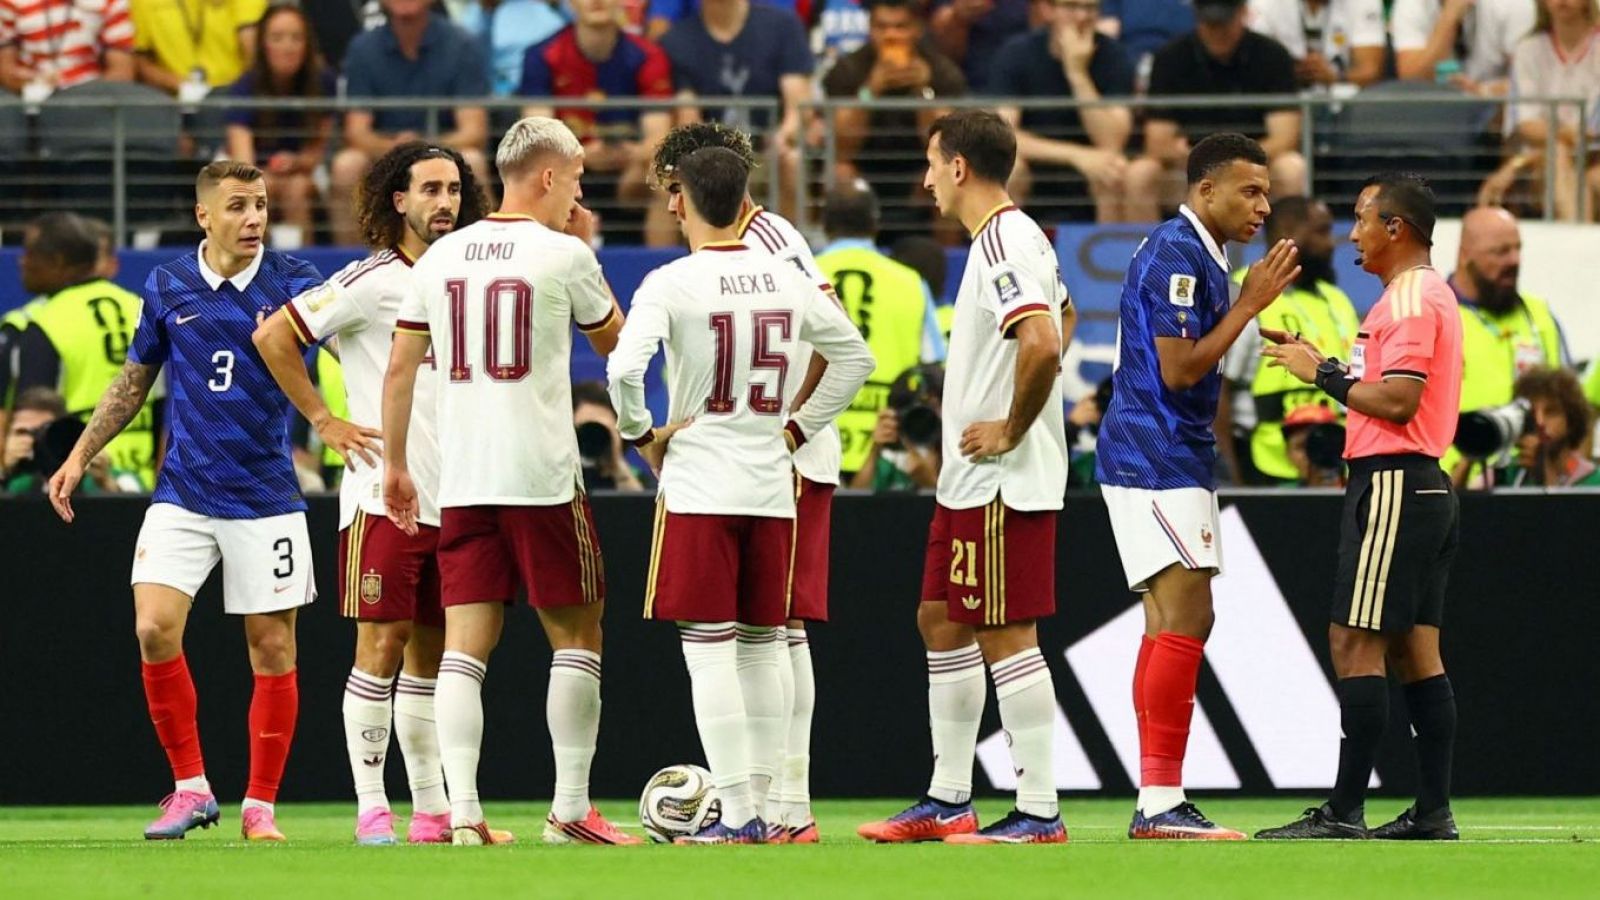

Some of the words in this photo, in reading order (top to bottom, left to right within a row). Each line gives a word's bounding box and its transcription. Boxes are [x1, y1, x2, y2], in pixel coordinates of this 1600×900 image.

[465, 242, 514, 261] OLMO
[720, 275, 760, 296] ALEX
[764, 274, 781, 295] B.
[445, 277, 534, 383] 10
[208, 350, 235, 392] 3
[705, 309, 793, 415] 15
[273, 537, 294, 579] 3
[949, 538, 978, 587] 21
